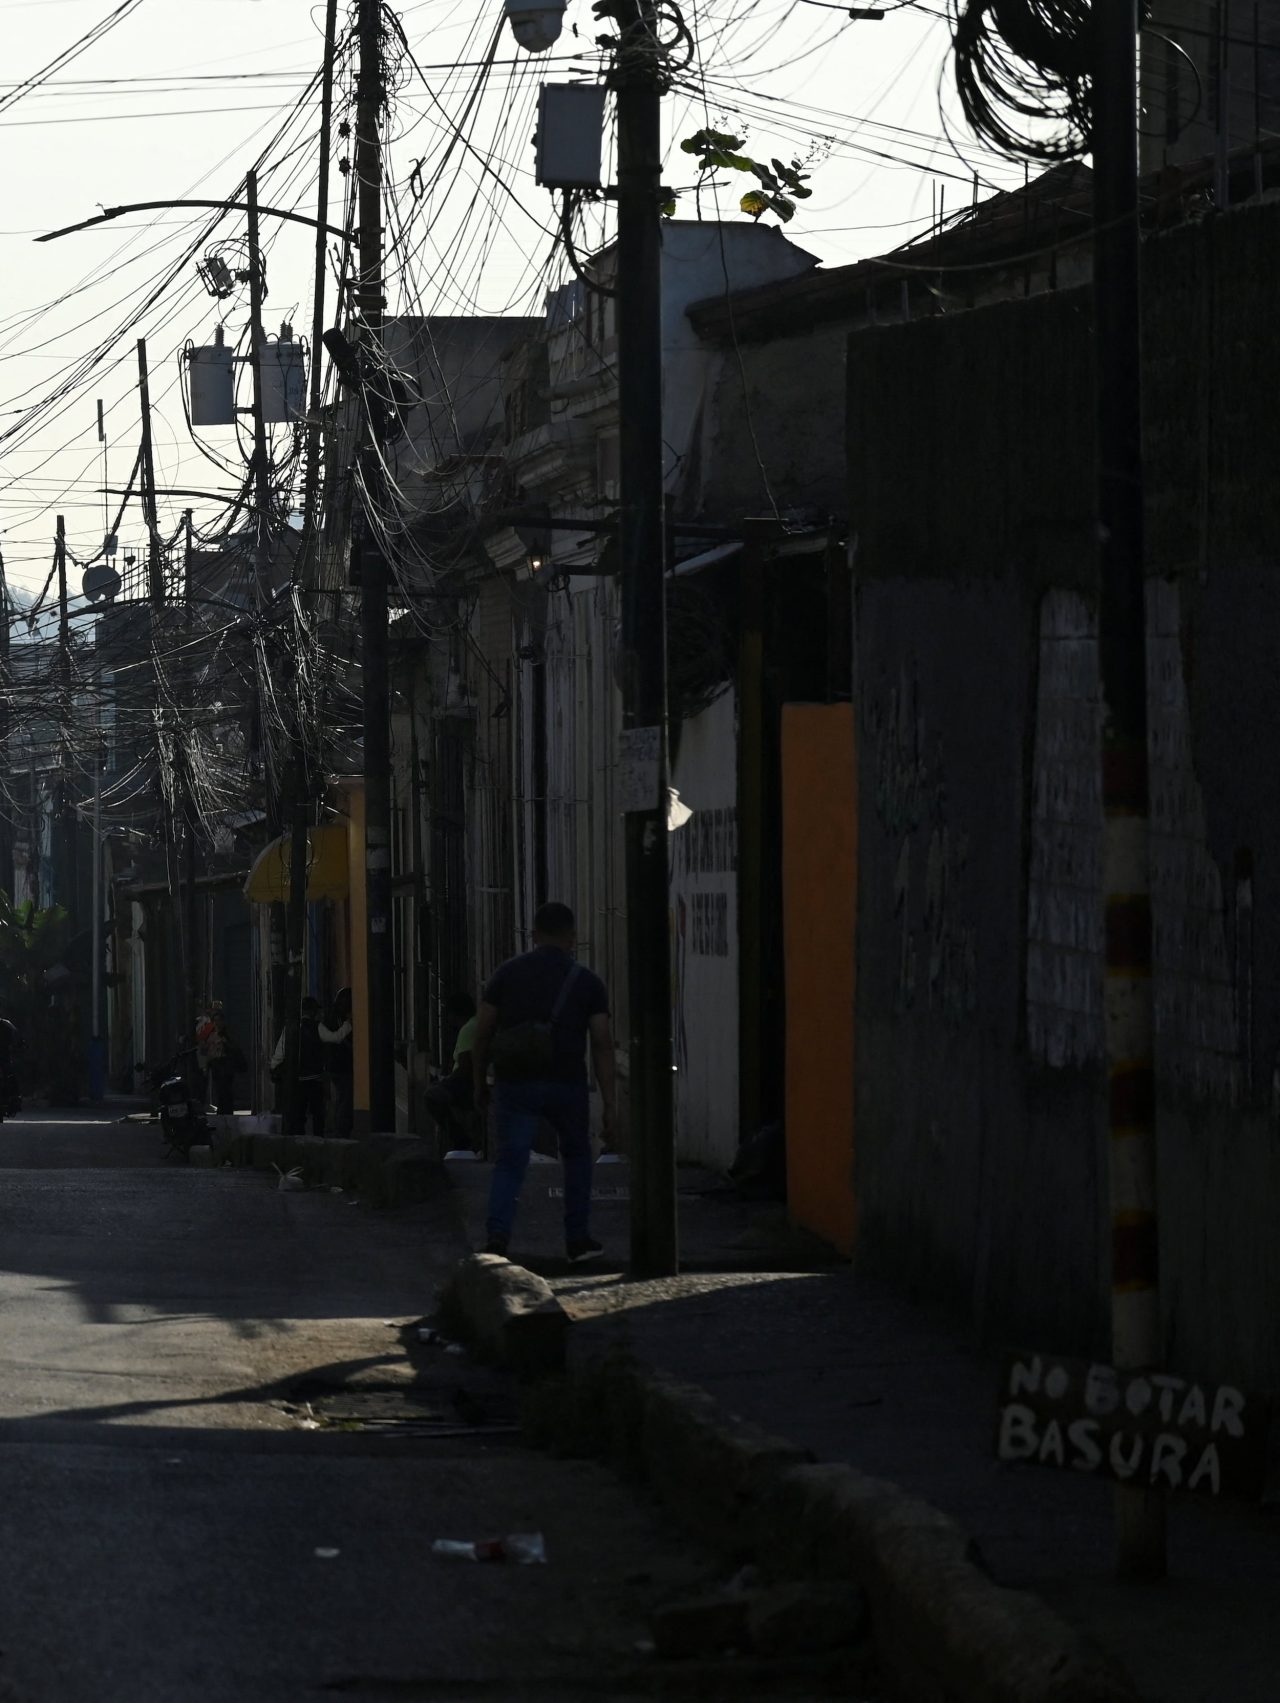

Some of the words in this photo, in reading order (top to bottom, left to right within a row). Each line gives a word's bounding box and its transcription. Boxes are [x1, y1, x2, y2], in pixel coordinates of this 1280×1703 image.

[1009, 1354, 1070, 1400] NO
[1084, 1363, 1247, 1440] BOTAR
[997, 1402, 1221, 1496] BASURA
